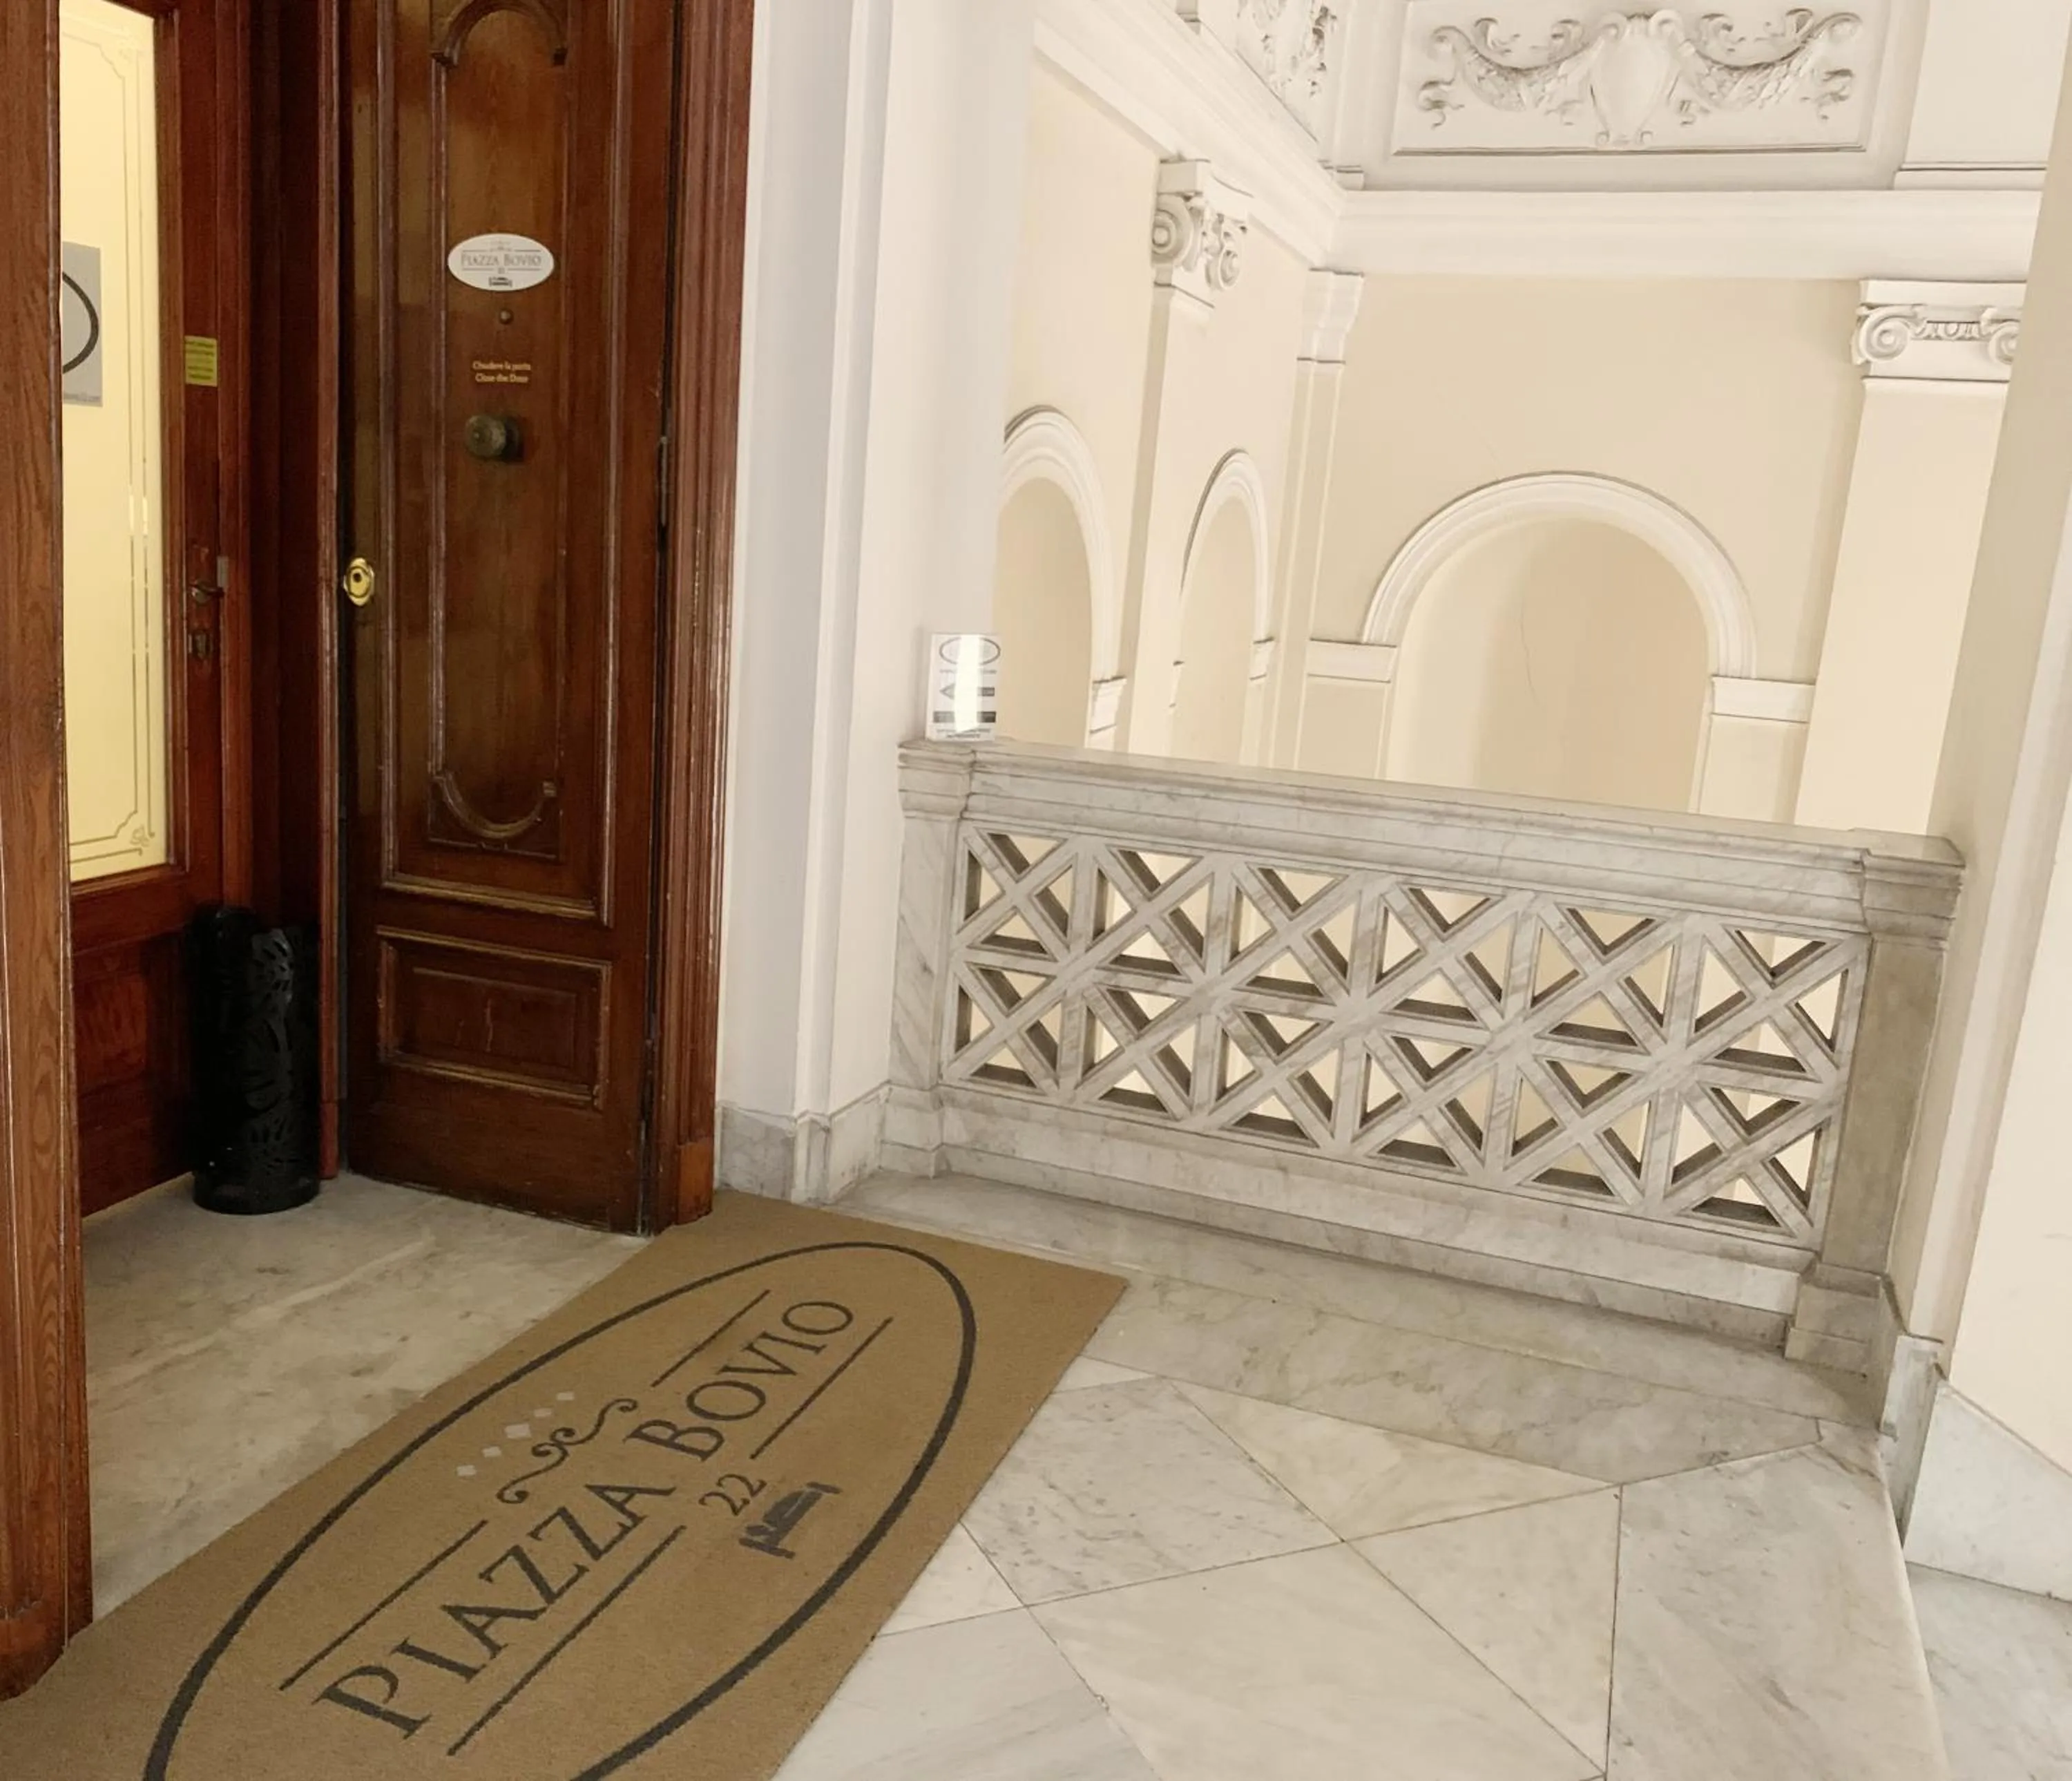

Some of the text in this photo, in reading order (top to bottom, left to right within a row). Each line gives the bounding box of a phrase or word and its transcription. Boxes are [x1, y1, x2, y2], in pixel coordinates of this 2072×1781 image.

[461, 253, 541, 267] PIAZZA BOVIO
[699, 1474, 766, 1516] 22
[314, 1301, 854, 1740] PIAZZA BOVIO
